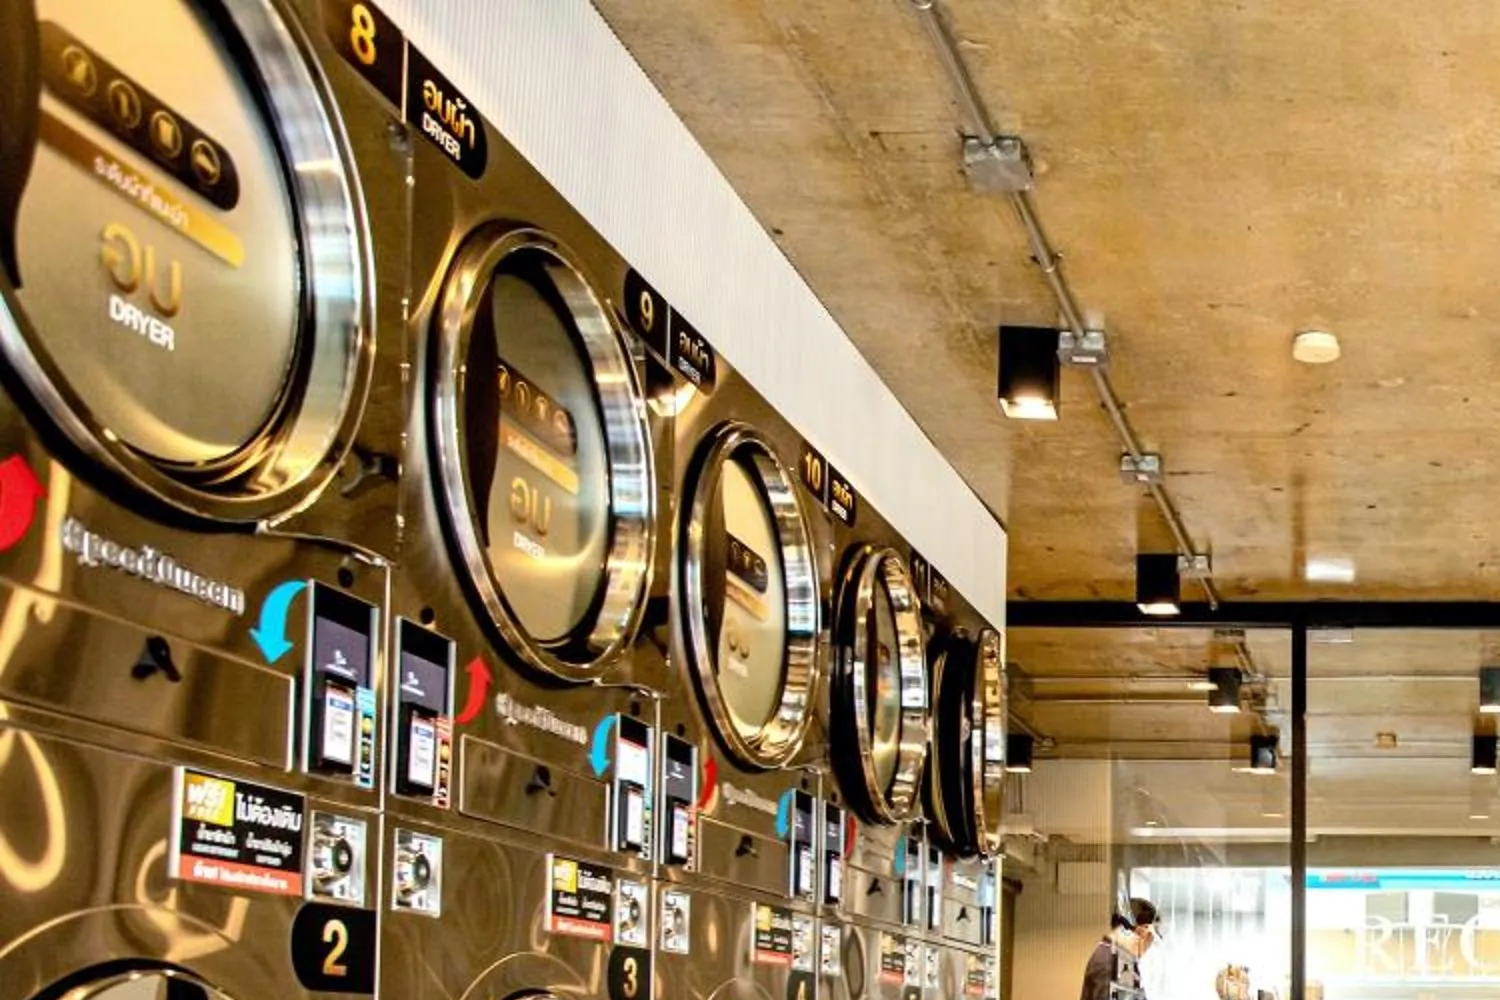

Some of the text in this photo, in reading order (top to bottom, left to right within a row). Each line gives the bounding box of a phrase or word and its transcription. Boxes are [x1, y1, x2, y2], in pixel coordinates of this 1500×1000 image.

[351, 3, 376, 65] 8
[422, 79, 475, 149] อบผ้า
[422, 112, 461, 161] DRYER
[101, 221, 181, 318] อบ
[109, 294, 175, 351] DRYER
[641, 291, 653, 333] 9
[805, 452, 821, 490] 10
[322, 918, 349, 977] 2
[623, 955, 638, 997] 3
